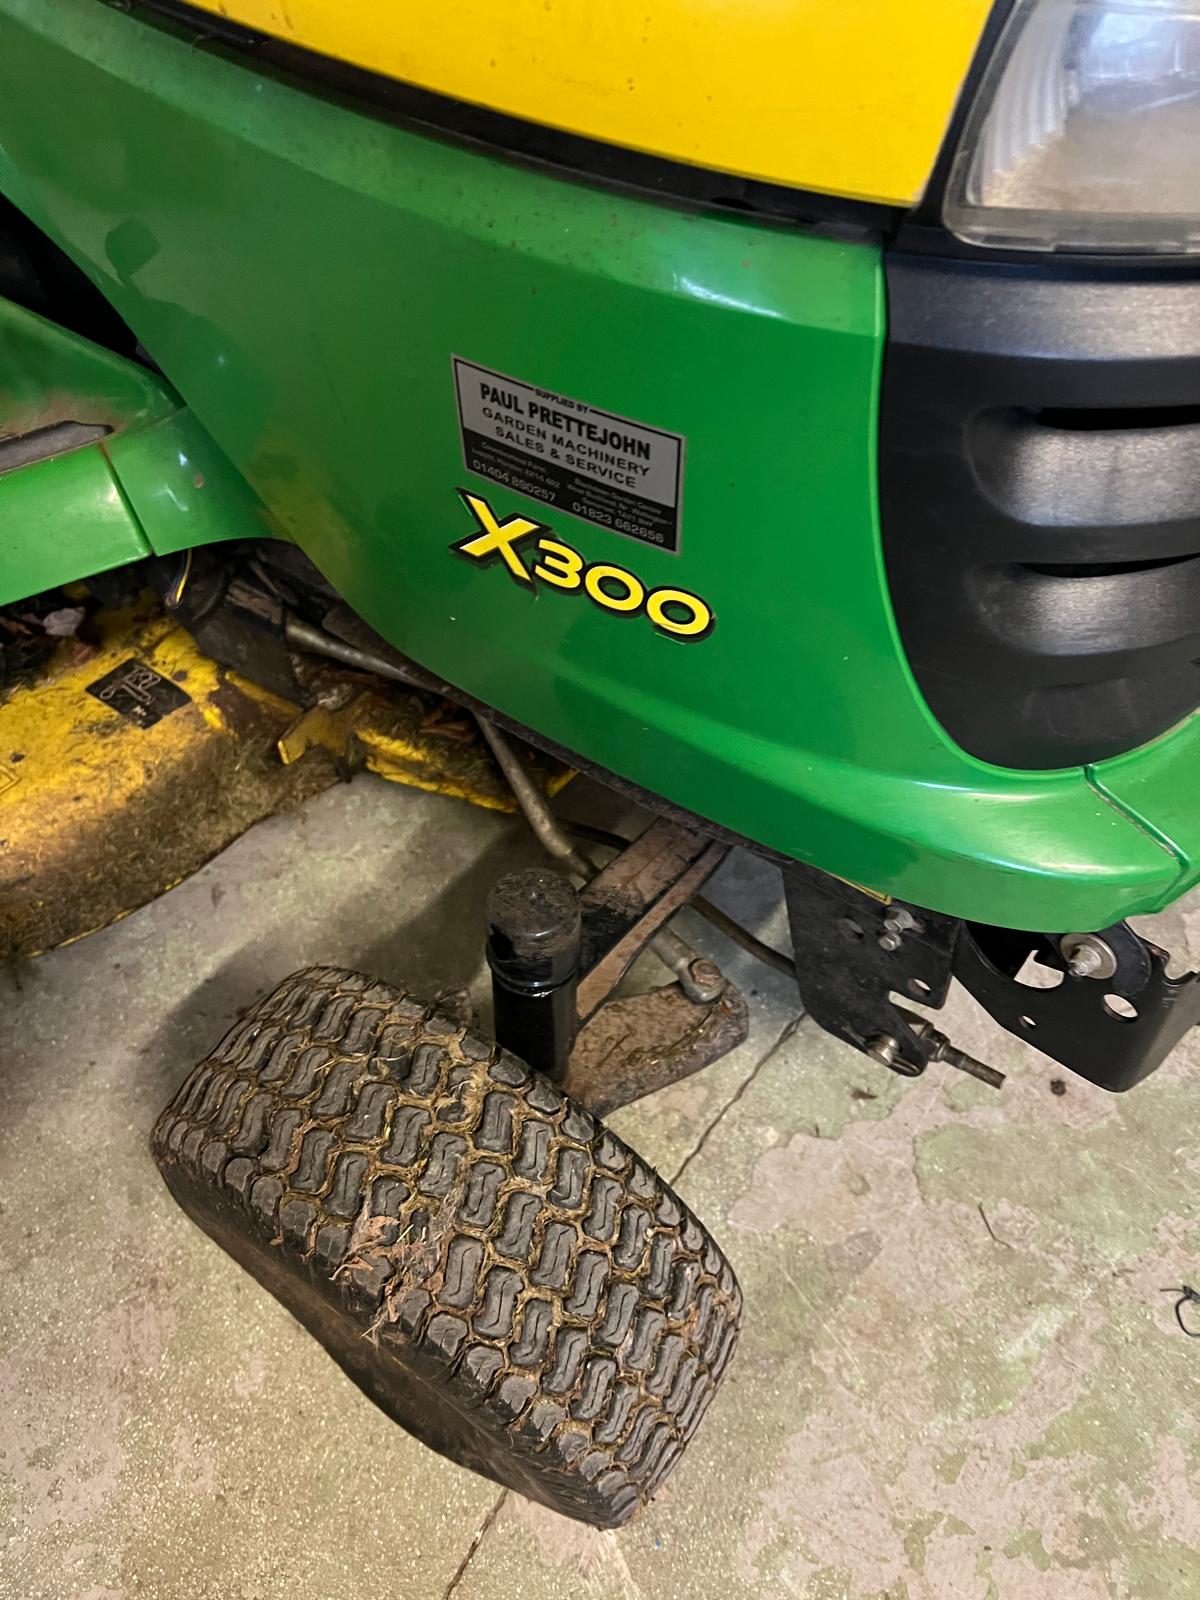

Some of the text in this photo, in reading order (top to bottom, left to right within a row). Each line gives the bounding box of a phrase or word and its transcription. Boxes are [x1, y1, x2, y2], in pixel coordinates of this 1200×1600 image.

[480, 382, 524, 415] PAUL
[528, 401, 650, 460] PRETTEJOHN
[482, 407, 546, 440] GARDEN
[552, 433, 650, 476] MACHINERY
[495, 425, 545, 453] SALES
[550, 448, 560, 460] &
[565, 454, 637, 488] SERVICE
[451, 489, 714, 641] X300
